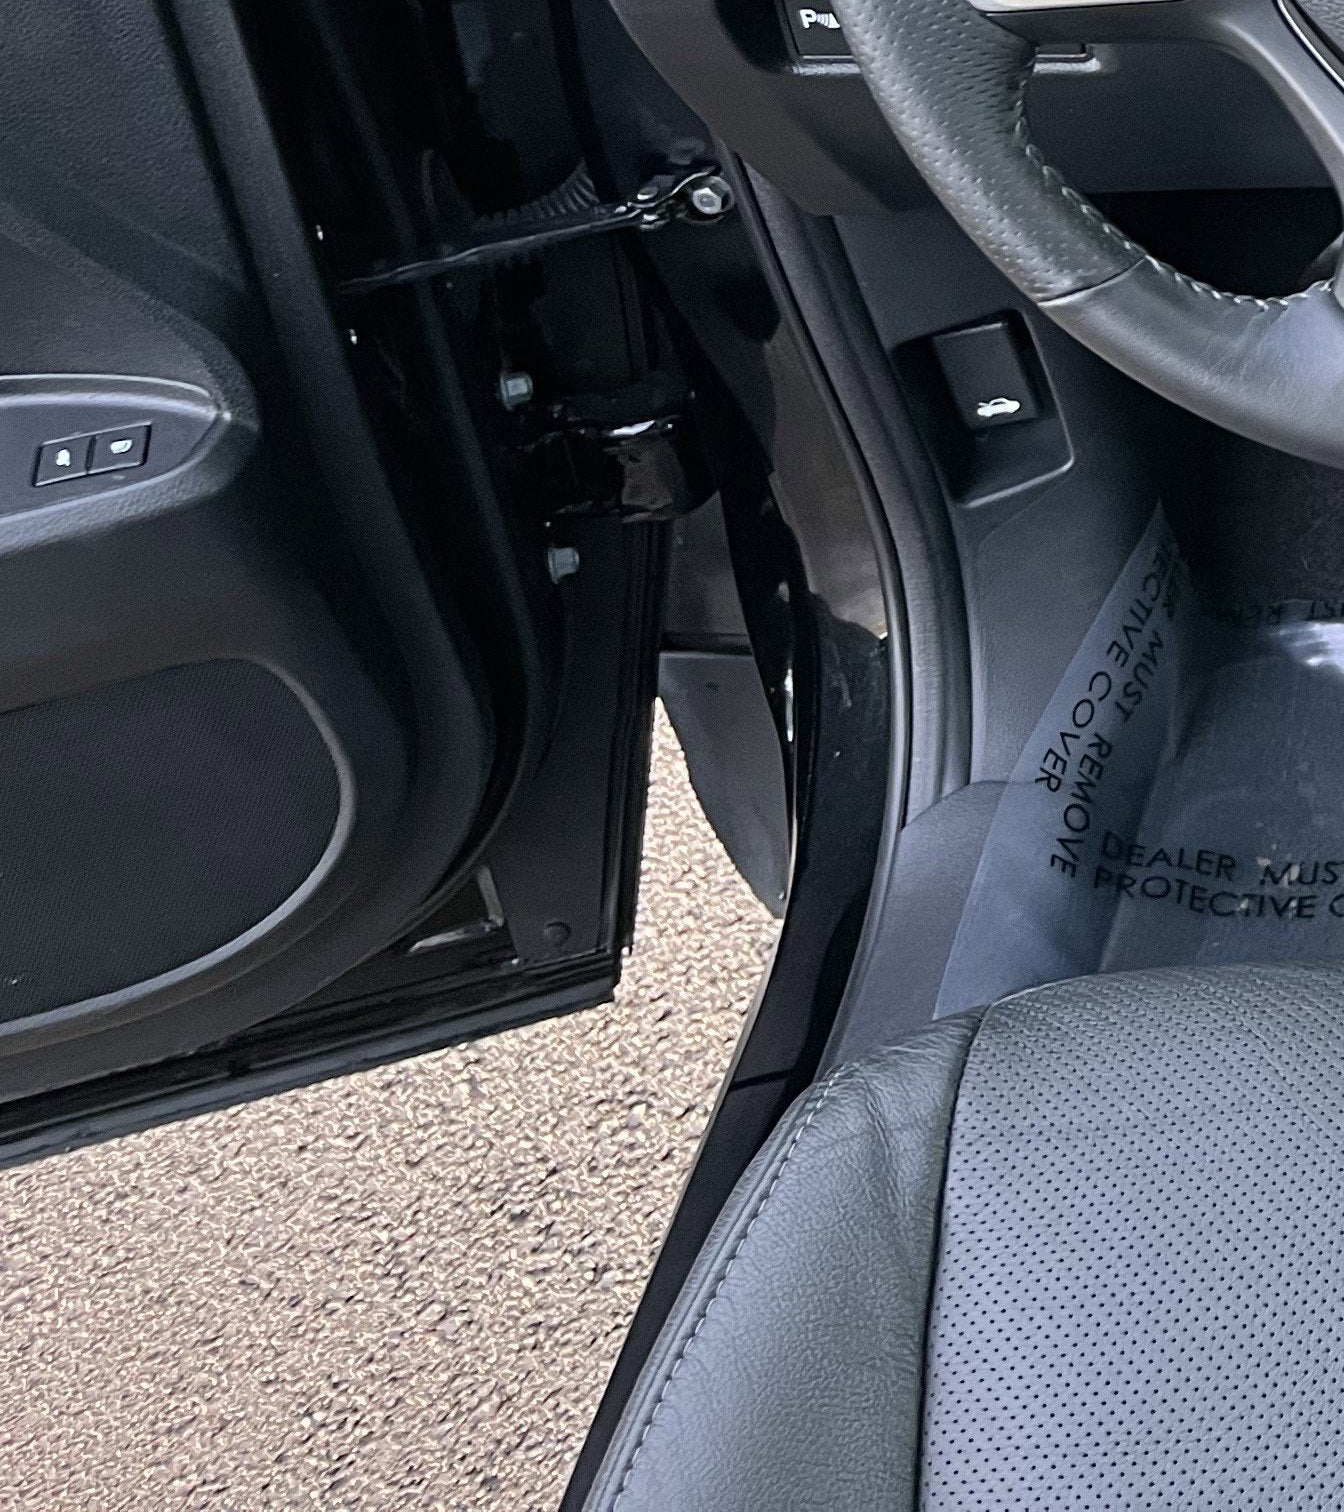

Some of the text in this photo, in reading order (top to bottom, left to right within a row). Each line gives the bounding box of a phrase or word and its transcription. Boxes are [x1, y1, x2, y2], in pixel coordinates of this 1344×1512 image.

[1034, 669, 1114, 795] COVER
[1050, 628, 1166, 879] MUST REMOVE
[1092, 865, 1319, 921] PROTECTIVE
[1100, 829, 1238, 882] DEALER
